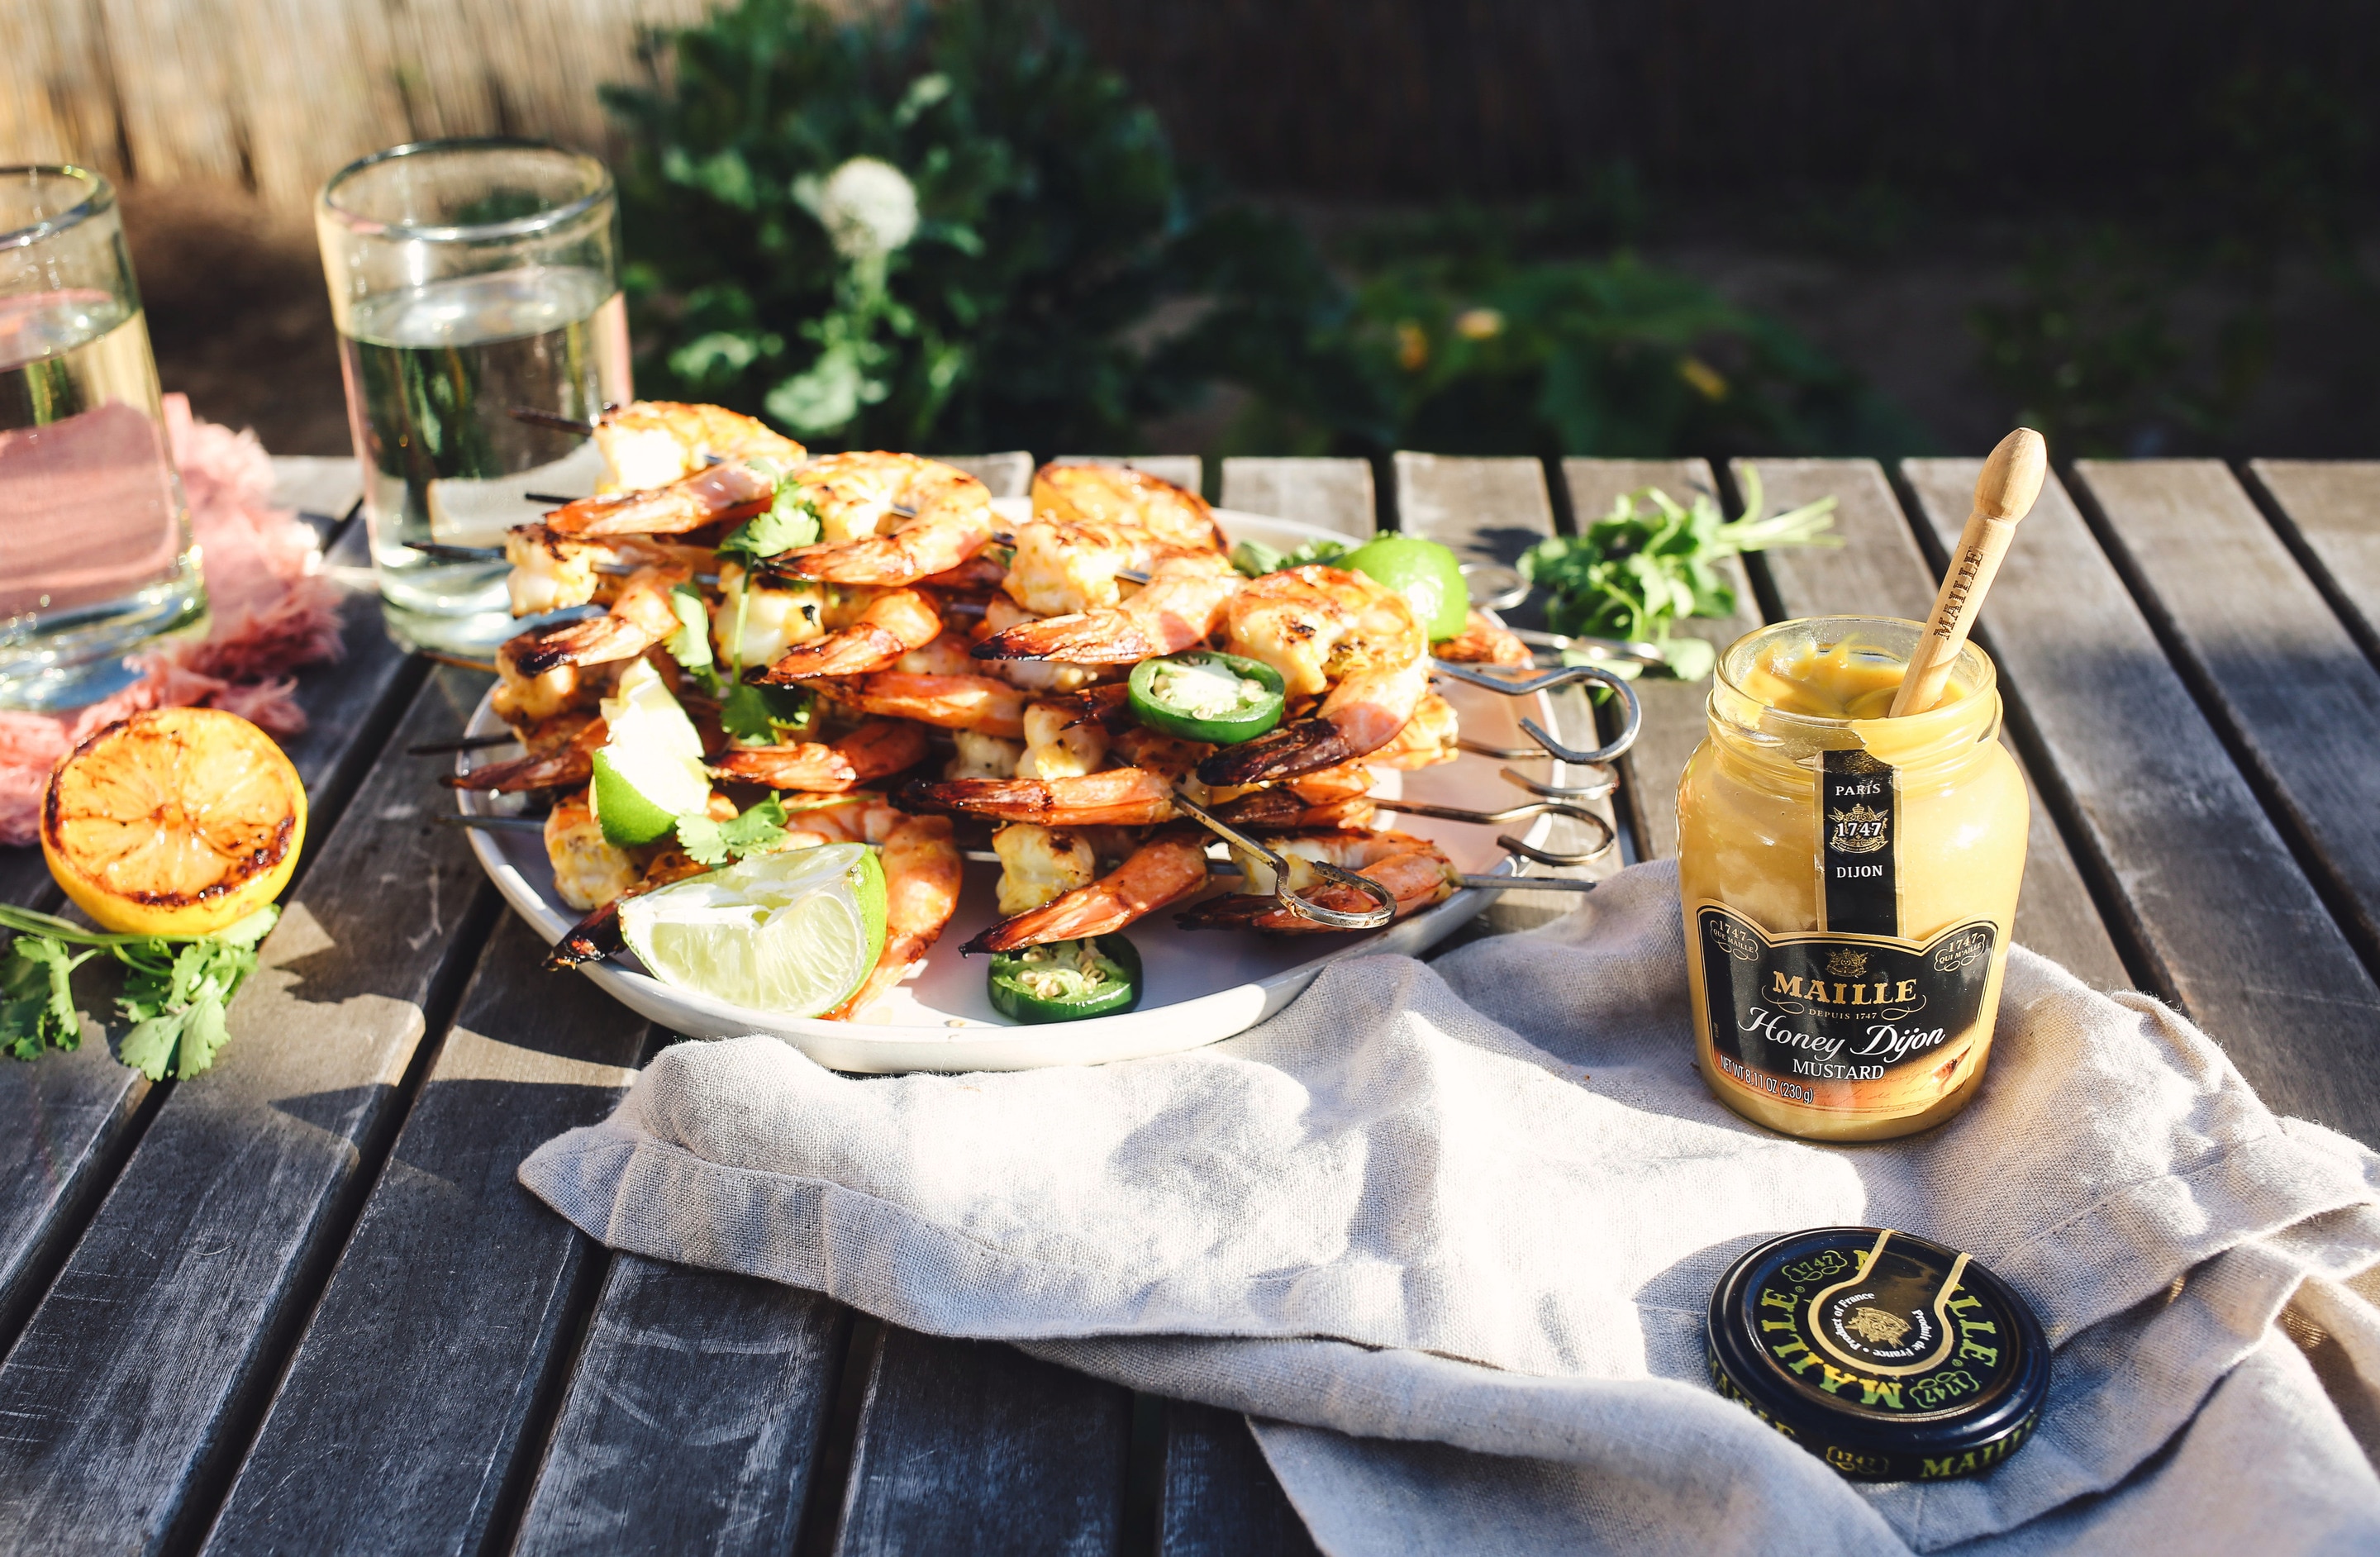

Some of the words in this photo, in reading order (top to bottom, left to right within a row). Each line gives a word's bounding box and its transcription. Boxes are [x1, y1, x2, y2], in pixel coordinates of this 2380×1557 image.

[1933, 548, 1983, 640] MAILLE
[1835, 783, 1881, 796] PARIS
[1837, 822, 1882, 837] 1747
[1836, 865, 1883, 878] DIJON
[1713, 928, 1726, 940] QUE
[1727, 937, 1754, 954] MAILLE
[1719, 921, 1747, 941] 1747
[1948, 932, 1978, 953] 1747
[1939, 952, 1954, 964] QUI
[1773, 970, 1917, 1005] MAILLE
[1808, 1008, 1849, 1020] DEPUIS
[1855, 1012, 1878, 1020] 1747
[1737, 1007, 1845, 1061] Honey
[1849, 1023, 1946, 1064] Dijon
[1721, 1054, 1732, 1074] NET
[1732, 1062, 1744, 1080] WT
[1745, 1069, 1764, 1089] 8.11
[1766, 1077, 1778, 1094] OZ
[1780, 1081, 1802, 1100] (230
[1804, 1088, 1814, 1104] g)
[1792, 1058, 1884, 1080] MUSTARD
[1791, 1255, 1834, 1276] 1747
[1838, 1292, 1876, 1308] France
[1833, 1305, 1844, 1317] of
[1831, 1318, 1862, 1350] Product
[1911, 1309, 1932, 1340] Produit
[1872, 1347, 1915, 1358] France
[1911, 1340, 1926, 1351] de
[1925, 1378, 1969, 1402] 1747
[1837, 1450, 1876, 1467] 1747
